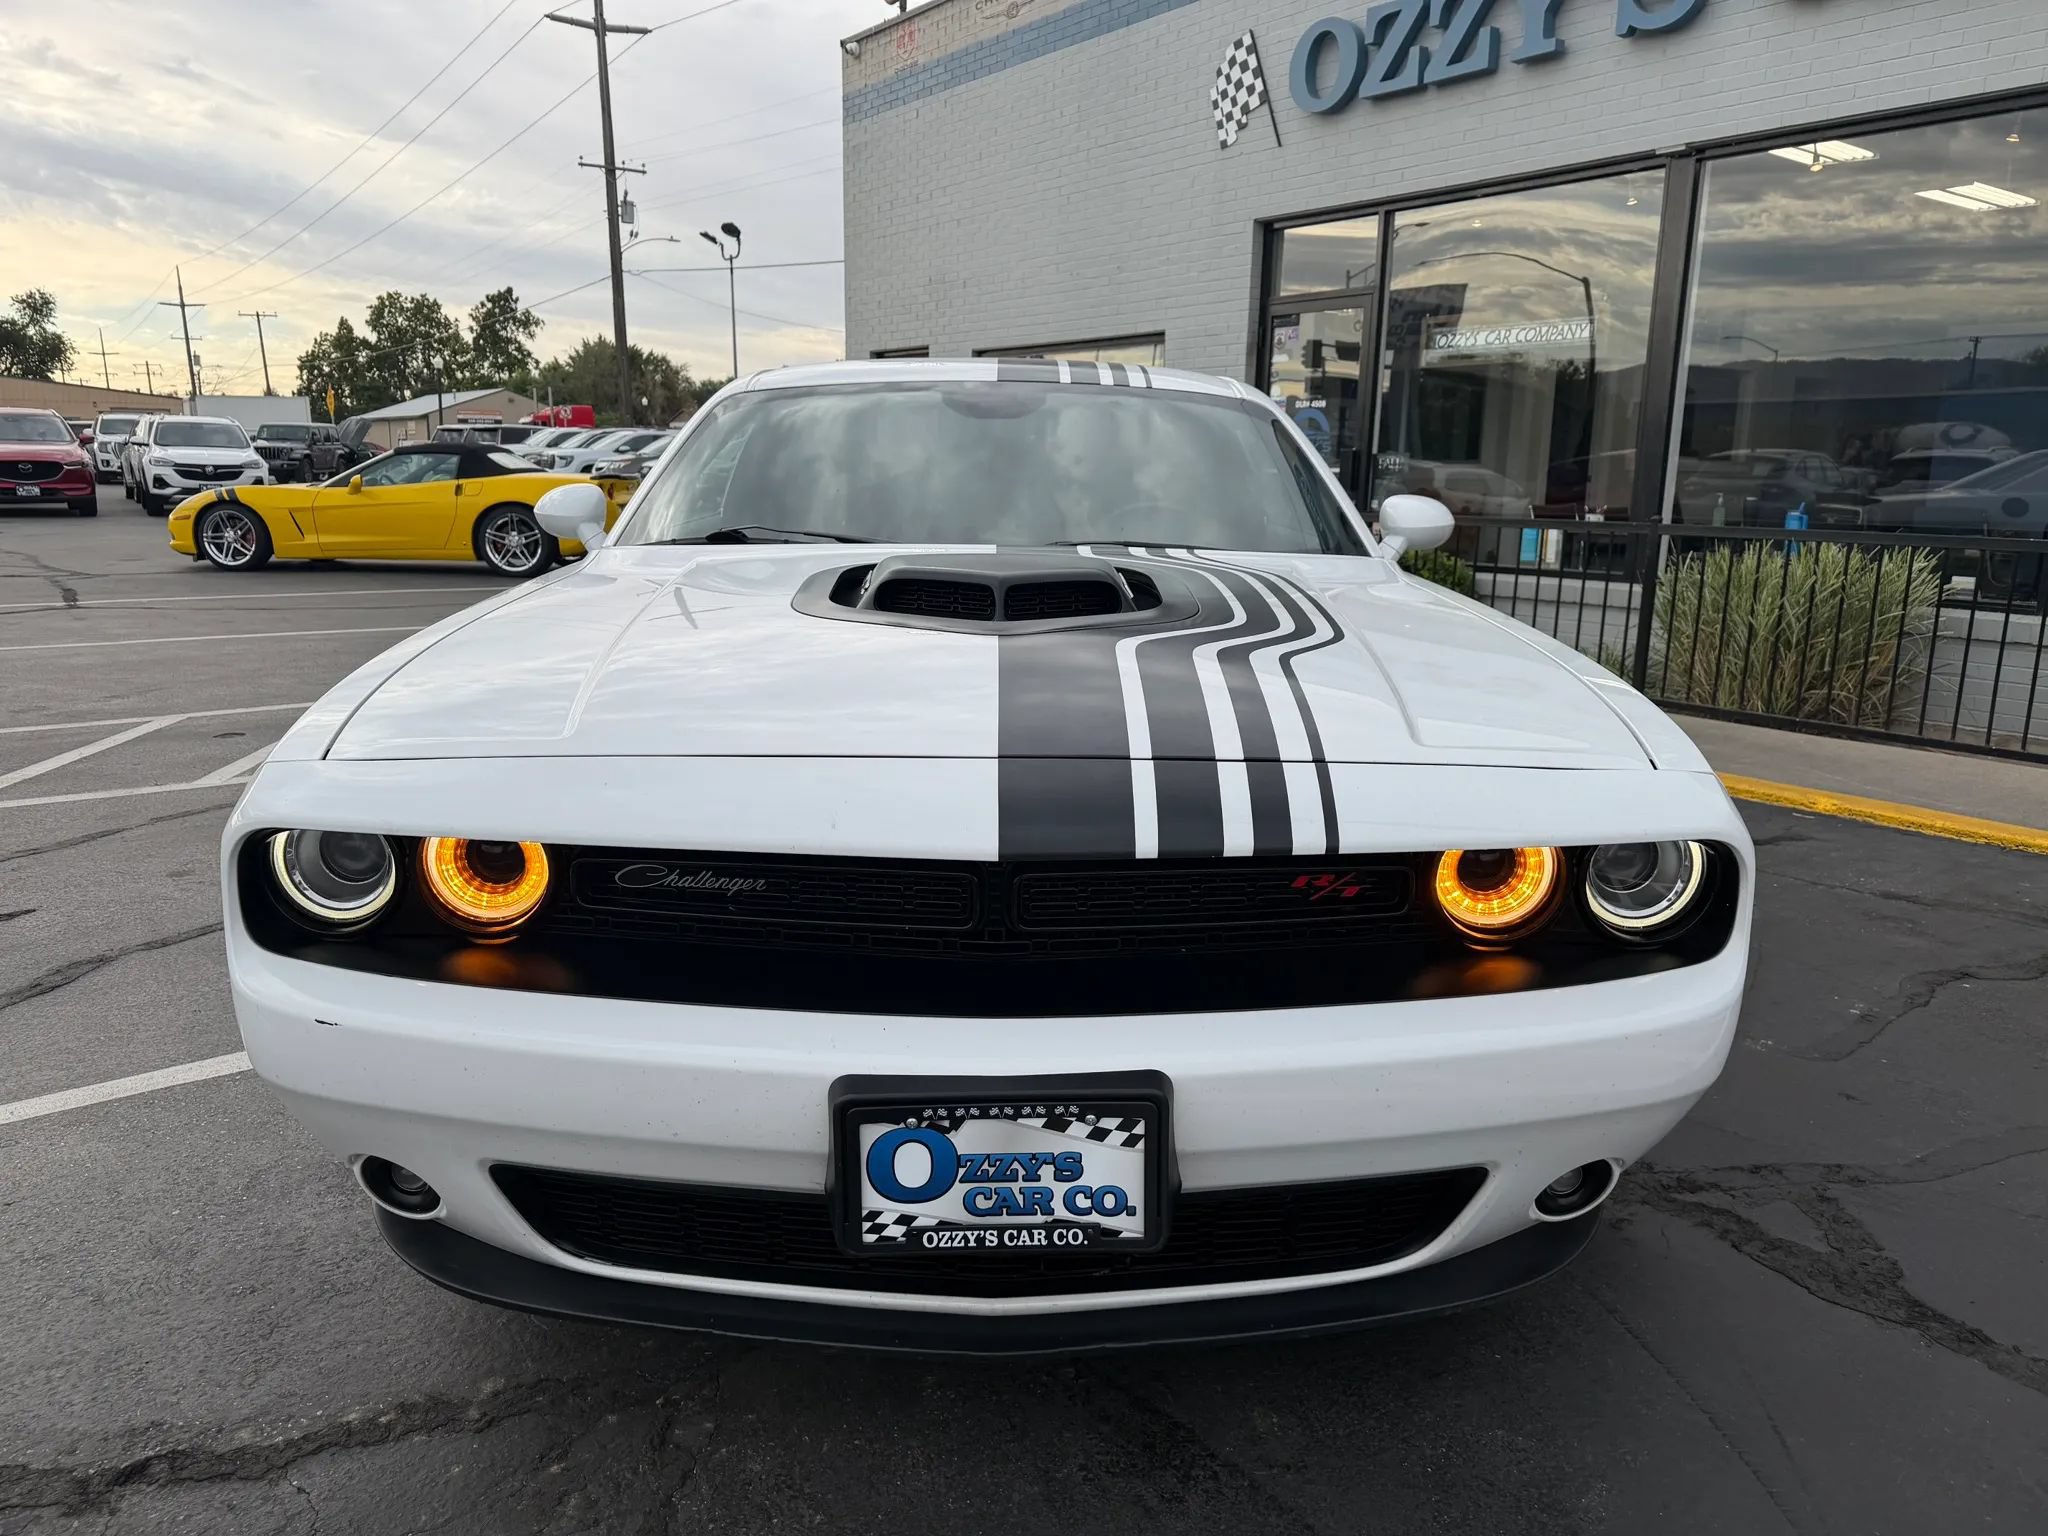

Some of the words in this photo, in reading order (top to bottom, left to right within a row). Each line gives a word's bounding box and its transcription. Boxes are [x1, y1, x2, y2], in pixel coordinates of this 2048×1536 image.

[1289, 0, 1708, 114] OZZY
[1485, 328, 1512, 346] CAR
[1515, 322, 1590, 344] COMPANY
[614, 863, 767, 895] Challenger
[1290, 871, 1361, 901] R/T
[866, 1127, 1084, 1204] OZZY'S
[963, 1185, 1054, 1217] CAR
[1062, 1184, 1137, 1216] CO.
[922, 1230, 998, 1248] OZZY'S
[1003, 1229, 1048, 1247] CAR
[1052, 1228, 1089, 1246] CO.
